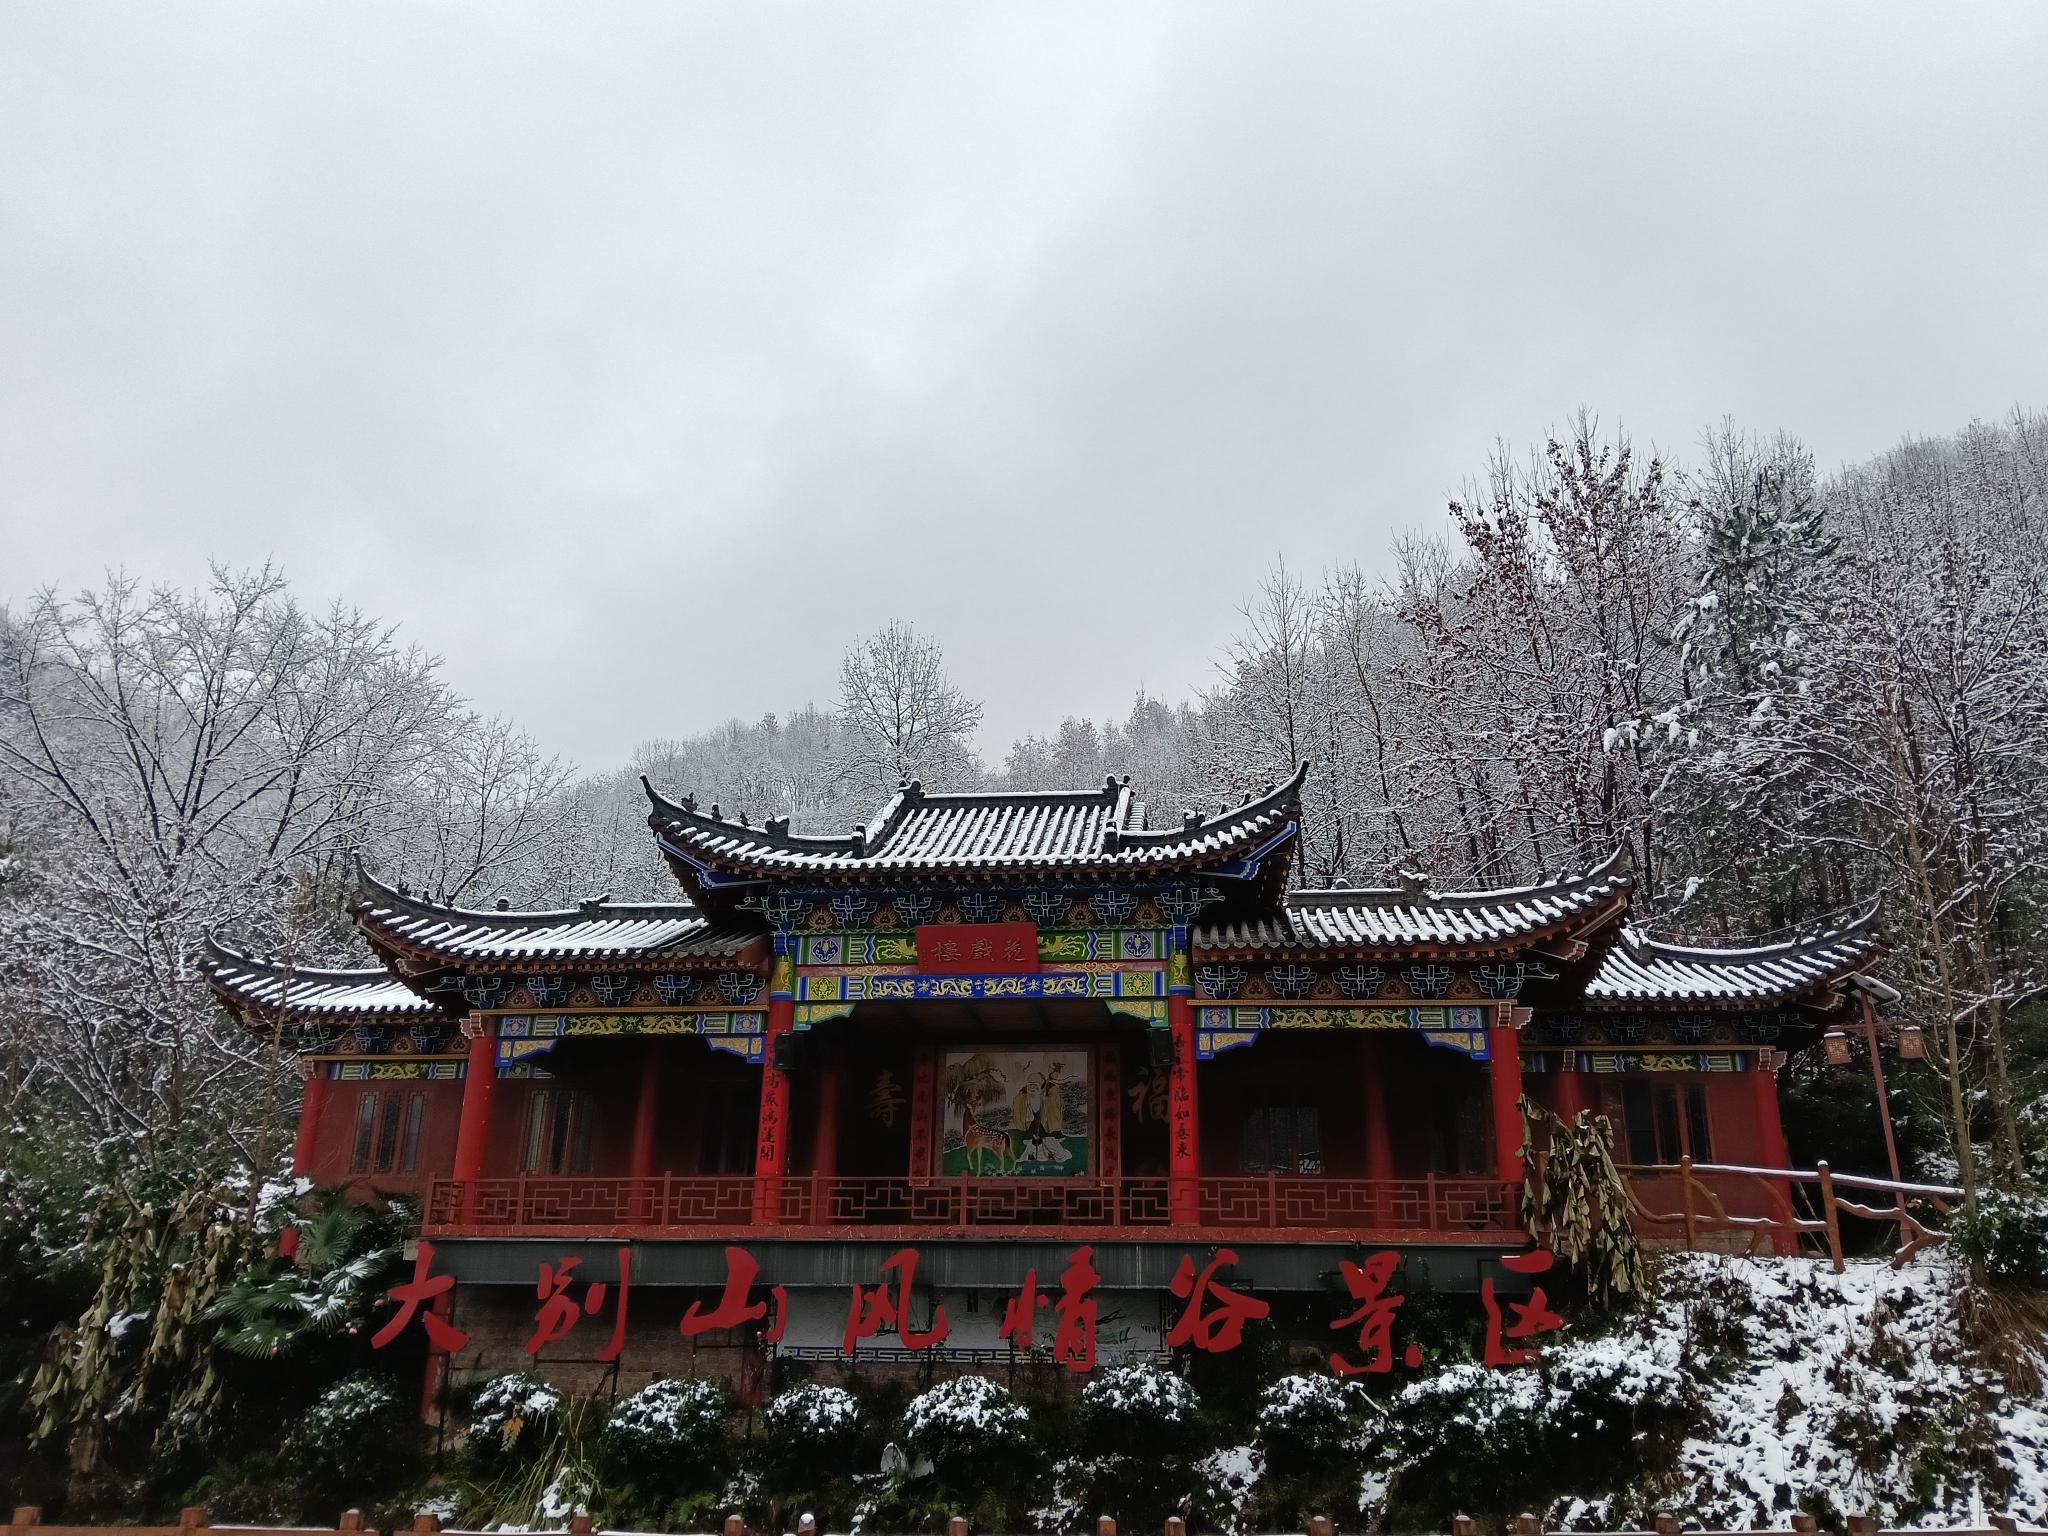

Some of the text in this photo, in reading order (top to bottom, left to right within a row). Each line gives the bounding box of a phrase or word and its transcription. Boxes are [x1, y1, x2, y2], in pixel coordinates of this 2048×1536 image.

[371, 1241, 1564, 1376] 大别山风情谷景区
